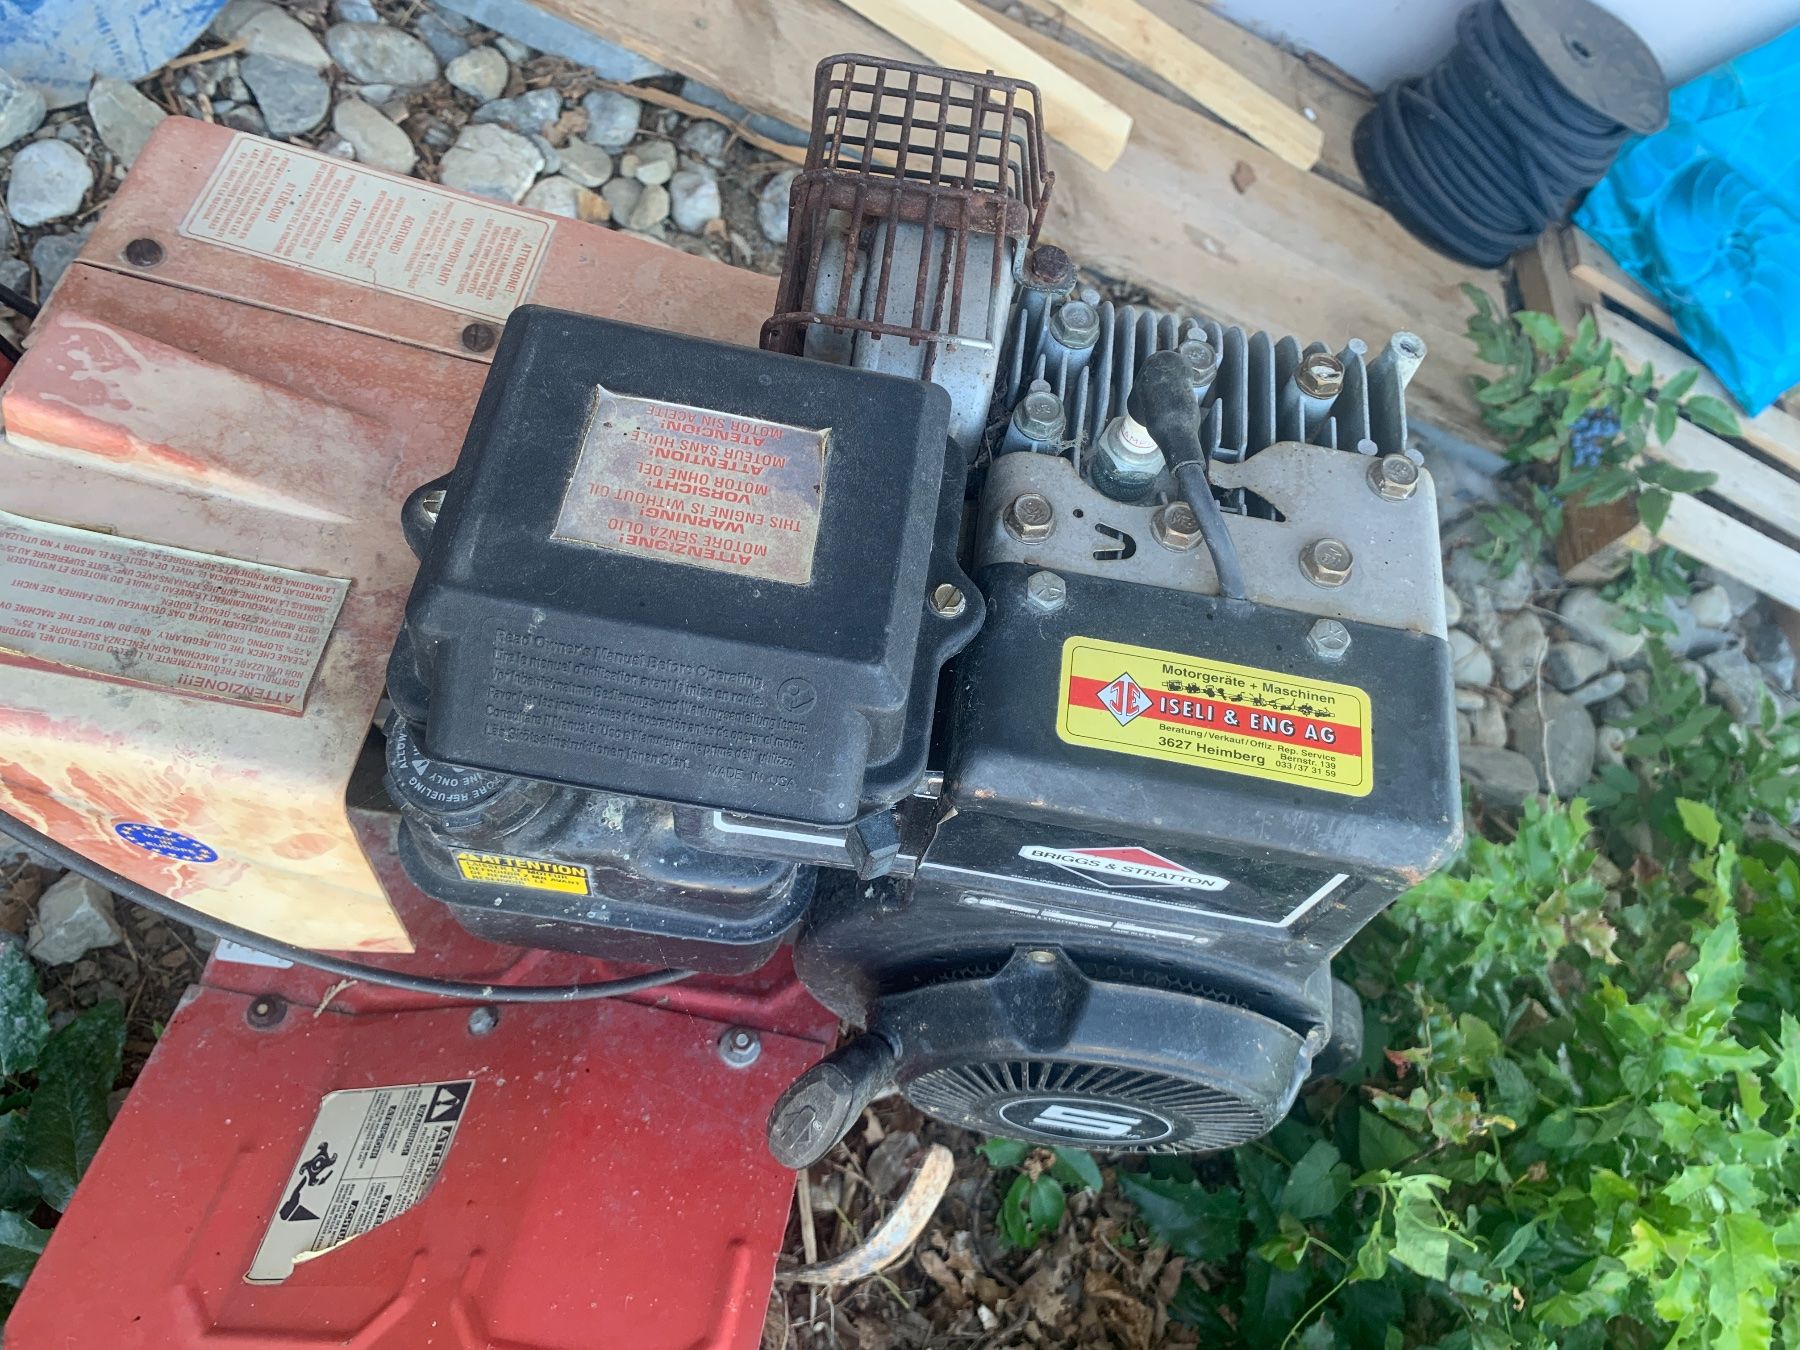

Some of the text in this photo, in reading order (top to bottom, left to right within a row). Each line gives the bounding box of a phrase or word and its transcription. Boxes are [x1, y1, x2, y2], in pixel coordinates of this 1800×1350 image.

[264, 181, 297, 223] ATENCION!
[330, 198, 363, 243] ATTENTION!
[387, 214, 416, 255] ACHTUNG!
[434, 216, 475, 286] VERY IMPORTANT!
[503, 242, 533, 293] ATTENZIONE!
[645, 404, 783, 439] MOTOR SIN ACEITE
[658, 419, 765, 447] ATENCION!
[629, 429, 786, 469] MOTEUR SANS HUILE
[647, 445, 764, 476] ATTENTION!
[633, 460, 768, 496] MOTOR OHNE OEL
[646, 476, 751, 505] VORSICHT!
[585, 482, 801, 532] THIS ENGINE IS WITHOUT OIL
[638, 505, 746, 534] WARNING!
[38, 538, 53, 548] NO
[53, 541, 60, 549] Y
[606, 517, 768, 557] MOTORE SENZA OLIO
[61, 542, 96, 557] MOTOR
[616, 532, 752, 566] ATTENZIONE!
[55, 564, 69, 574] ET
[69, 566, 109, 581] MOTEUR
[153, 561, 168, 571] DE
[168, 564, 195, 576] NIVEL
[215, 564, 270, 582] PENDIENTES
[9, 577, 39, 590] NICHT
[134, 570, 158, 581] AVEC
[207, 571, 262, 589] FRECUENCIA
[39, 583, 55, 593] SIE
[56, 587, 93, 601] FAHREN
[261, 582, 282, 593] CON
[95, 594, 115, 605] UND
[236, 590, 278, 605] MACHINE
[13, 603, 55, 618] MACHINE
[56, 611, 74, 621] THE
[166, 608, 185, 618] DAS
[36, 621, 47, 631] AL
[76, 615, 95, 625] USE
[96, 619, 116, 630] NOT
[117, 623, 131, 633] DO
[222, 618, 292, 639] KONTROLLIEREN
[38, 632, 54, 642] NEL
[48, 623, 101, 641] SUPERIORE
[132, 626, 152, 637] AND
[152, 643, 171, 653] CON
[212, 641, 227, 650] OIL
[227, 644, 245, 653] THE
[245, 638, 284, 651] SLOPING
[246, 647, 276, 659] CHECK
[171, 647, 220, 663] MACCHINA
[221, 656, 233, 665] LA
[276, 653, 308, 666] PLEASE
[594, 646, 644, 667] Manual
[647, 655, 693, 675] Before
[154, 653, 237, 677] FREQUENTEMENTE
[233, 658, 284, 675] UTILIZZARE
[238, 669, 300, 688] CONTROLLARE
[1162, 664, 1336, 705] Motorgeräte + Maschinen
[176, 672, 294, 704] ATTENZIONE!!!
[1159, 697, 1214, 722] ISELI
[1223, 710, 1241, 727] &
[1250, 713, 1296, 736] ENG
[1304, 726, 1337, 744] AG
[396, 733, 409, 769] ALLOW
[1158, 736, 1266, 766] 3627 Heimberg
[1277, 744, 1299, 756] Rep.
[1301, 747, 1336, 762] Service
[1280, 753, 1337, 770] Bernstr. 139
[428, 772, 459, 787] ONLY
[706, 764, 744, 780] MADE
[749, 771, 763, 783] IN
[1325, 768, 1337, 778] 59
[408, 776, 468, 802] REFUELING
[480, 854, 586, 877] ATTENTION
[1032, 849, 1217, 888] BRIGGS & STRATTON
